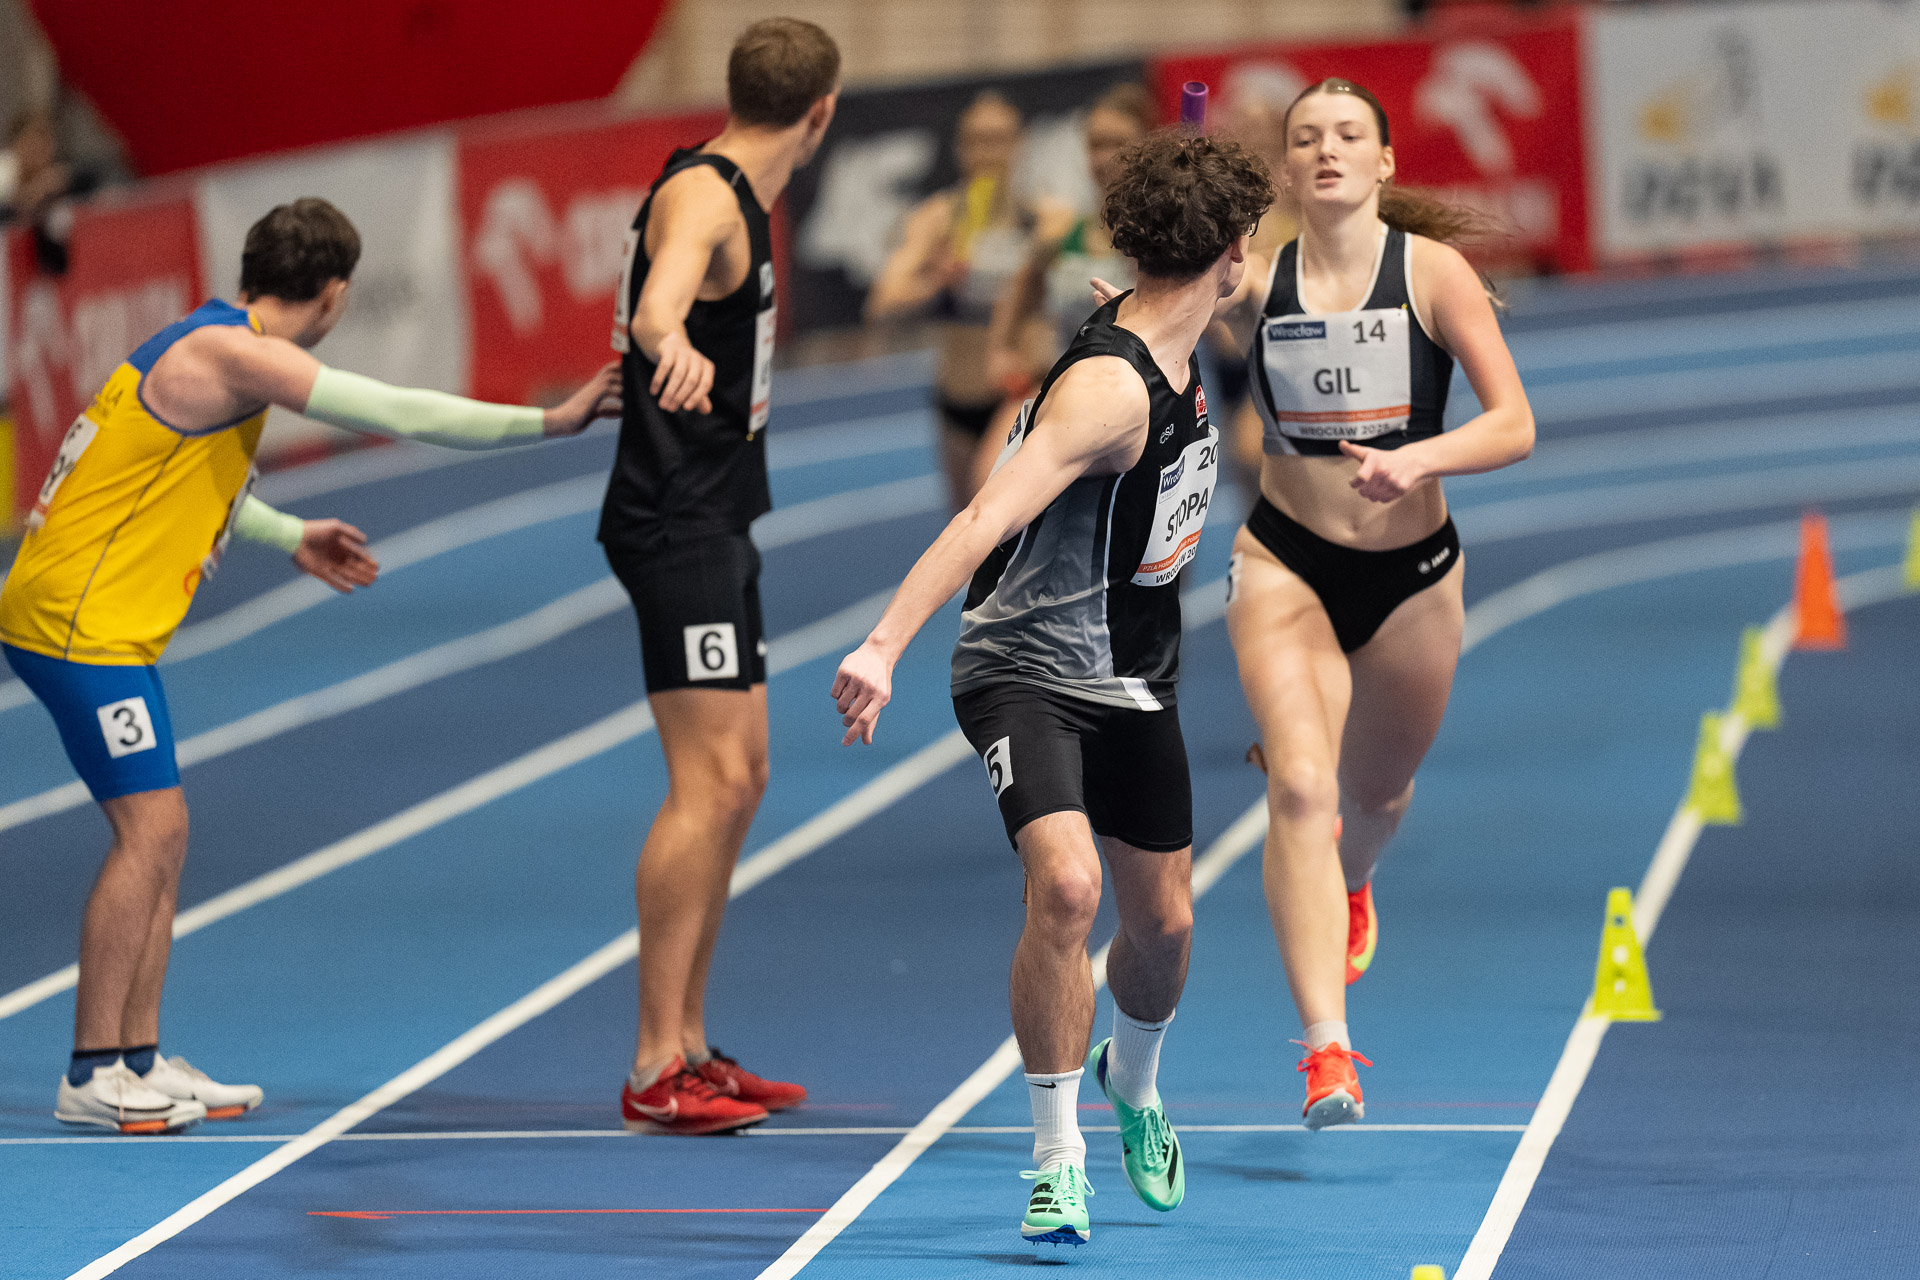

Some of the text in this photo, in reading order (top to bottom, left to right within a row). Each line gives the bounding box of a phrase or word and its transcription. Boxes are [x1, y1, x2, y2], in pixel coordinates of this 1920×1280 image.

[1352, 319, 1386, 344] 14
[1313, 367, 1360, 395] GIL
[1159, 423, 1175, 445] esa
[1165, 487, 1208, 543] STOPA
[699, 630, 725, 671] 6
[112, 706, 143, 747] 3
[986, 744, 1003, 795] 5
